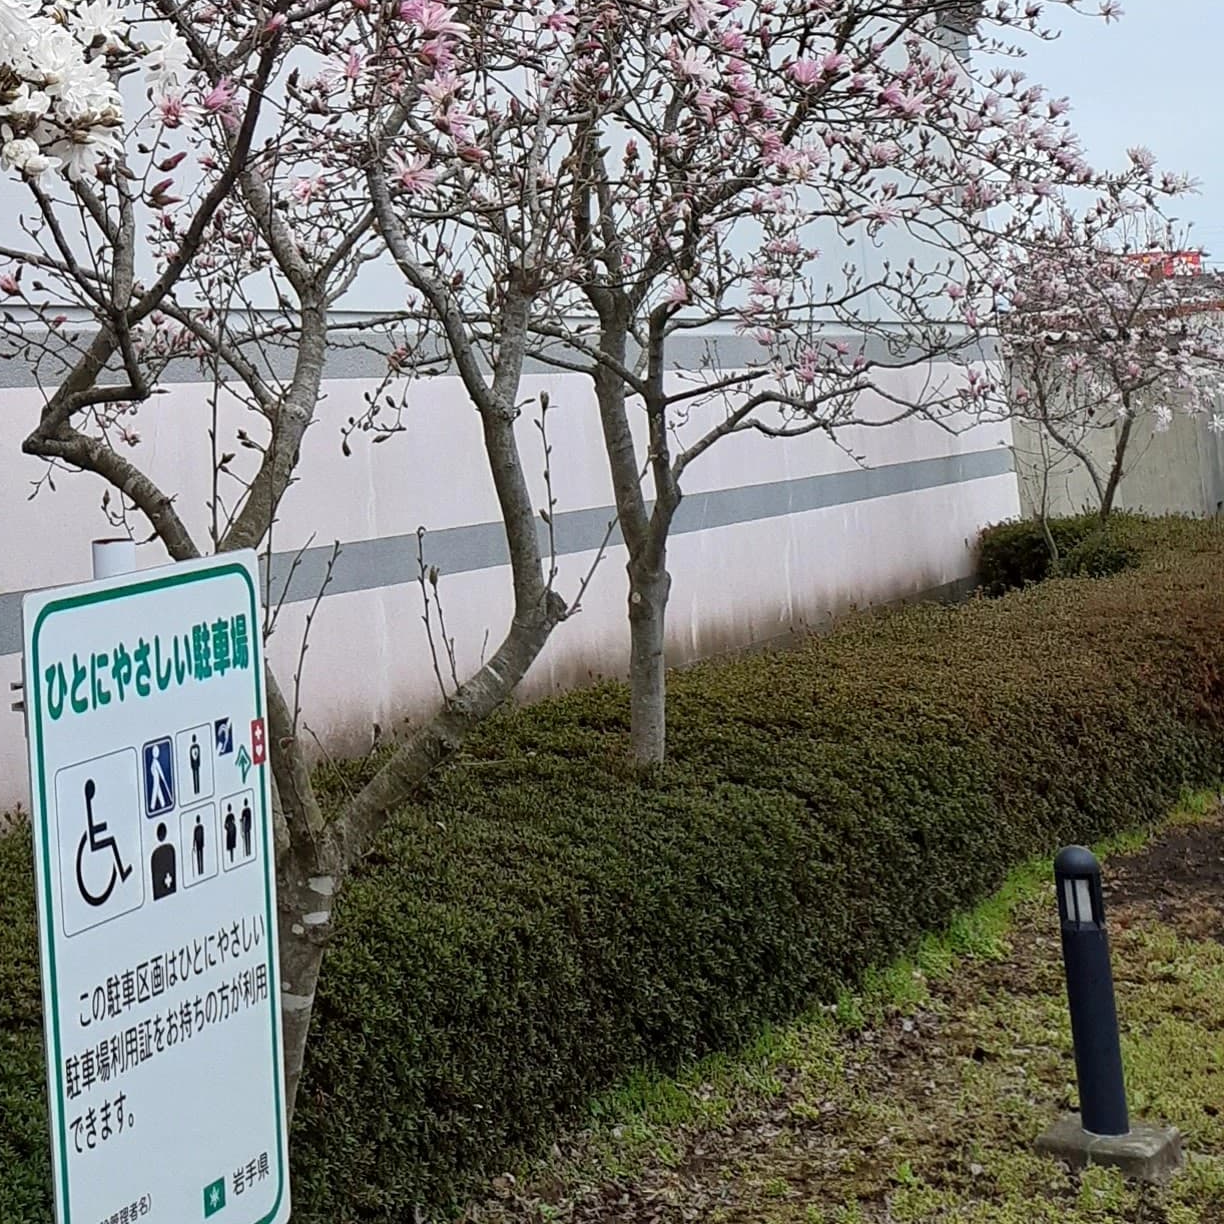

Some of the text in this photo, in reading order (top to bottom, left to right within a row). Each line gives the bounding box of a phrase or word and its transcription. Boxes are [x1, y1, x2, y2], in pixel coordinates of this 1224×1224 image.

[45, 614, 249, 720] ひとにやさしい駐車場
[80, 914, 265, 1027] この駐車区画はひとにやさしい
[65, 963, 267, 1100] 駐車場利用証をお持ちの方が利用
[69, 1091, 134, 1154] できます。
[233, 1152, 269, 1195] 岩手県
